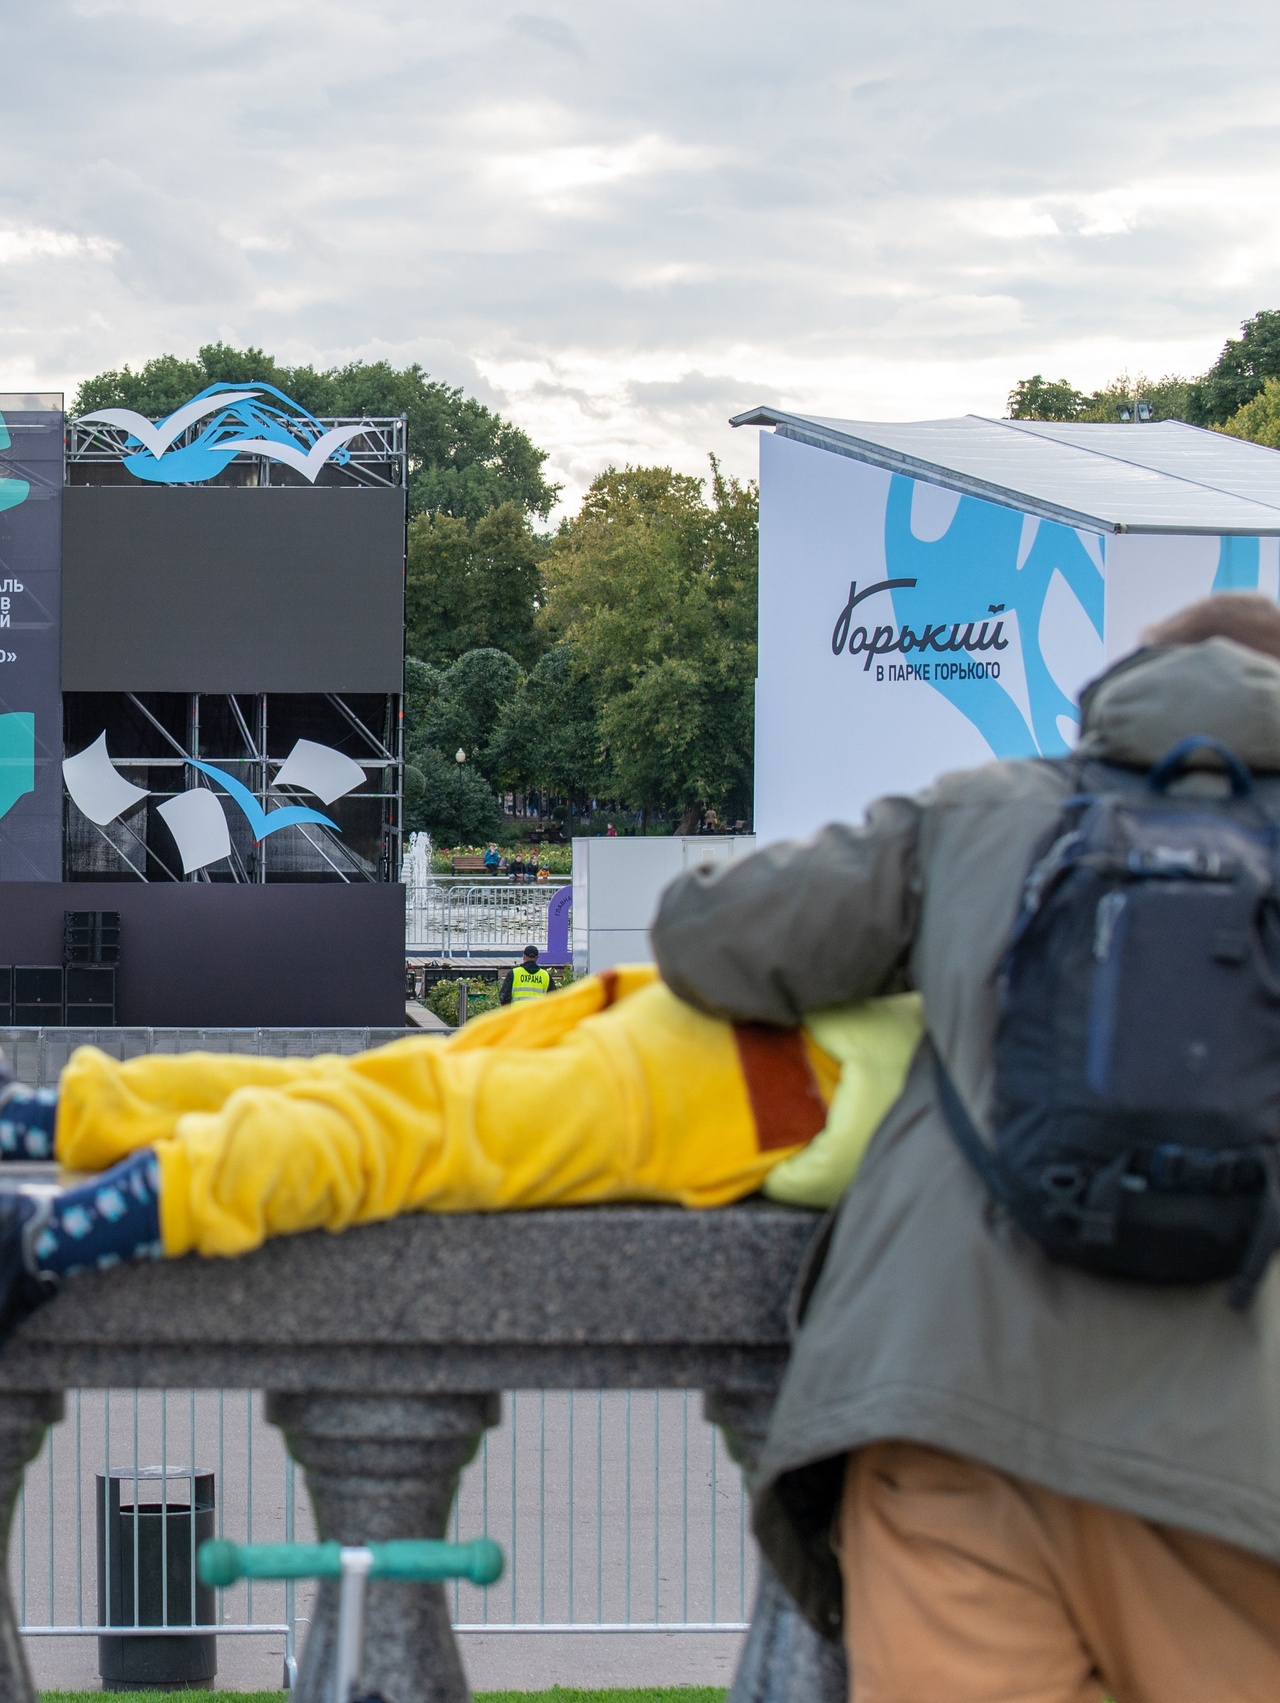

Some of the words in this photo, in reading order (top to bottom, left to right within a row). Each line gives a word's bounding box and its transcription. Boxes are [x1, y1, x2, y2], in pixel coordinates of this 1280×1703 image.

[831, 578, 1009, 671] Горький
[876, 665, 884, 682] В
[888, 664, 930, 681] ПАРКЕ
[935, 661, 1001, 680] ГОРЬКОГО
[520, 974, 543, 984] ОХРАНА
